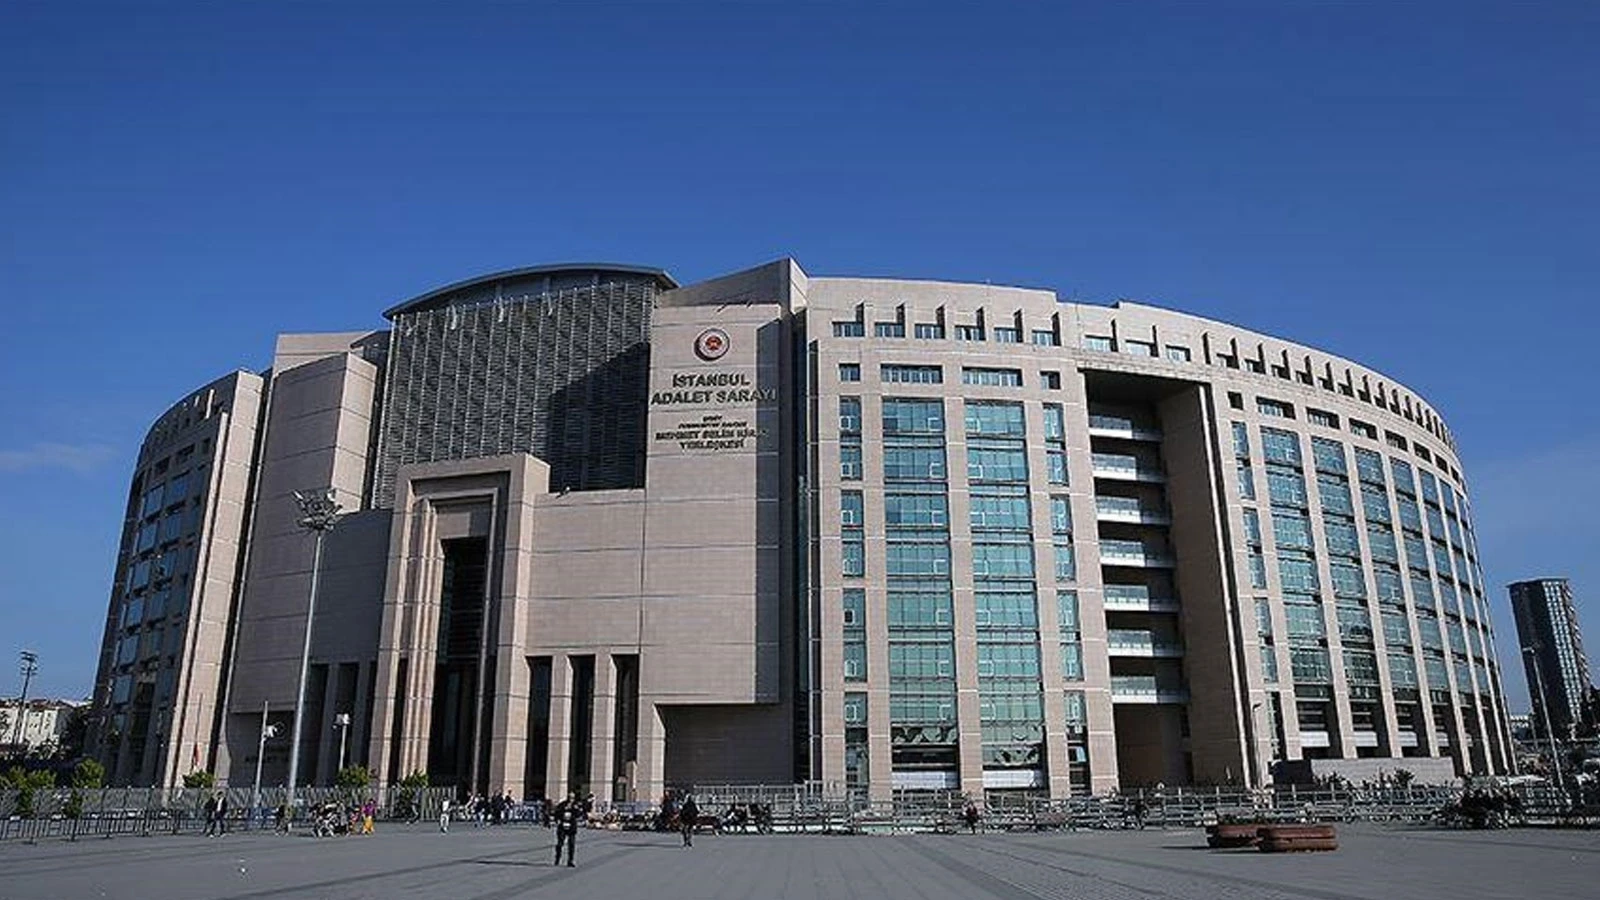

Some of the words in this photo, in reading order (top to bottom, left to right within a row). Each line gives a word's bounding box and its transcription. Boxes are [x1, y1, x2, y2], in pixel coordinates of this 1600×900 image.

[672, 373, 751, 388] İSTANBUL
[651, 391, 713, 405] ADALET
[716, 388, 776, 403] SARAYI
